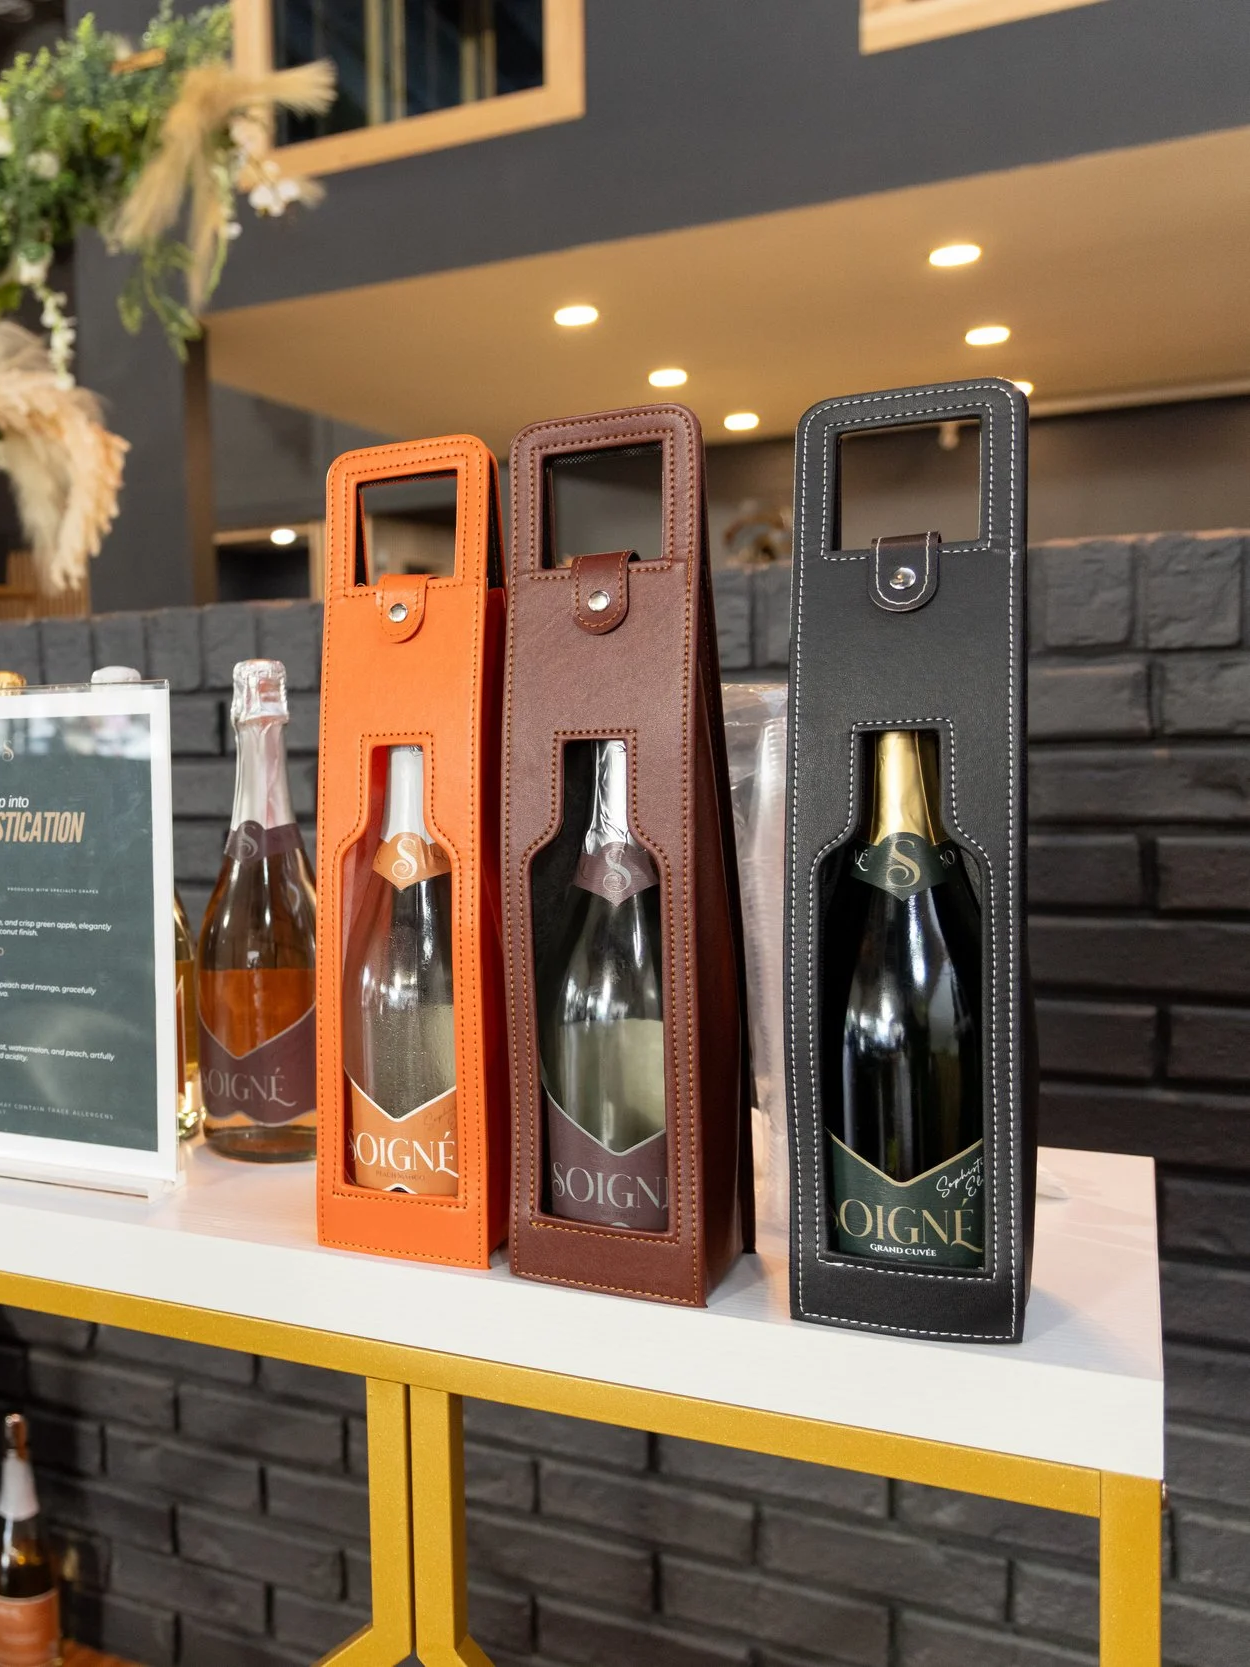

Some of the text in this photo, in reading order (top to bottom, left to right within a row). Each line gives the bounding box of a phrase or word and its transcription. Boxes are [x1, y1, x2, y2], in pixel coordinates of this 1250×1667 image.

[8, 795, 29, 808] into
[392, 838, 417, 879] S
[886, 839, 921, 888] S
[603, 849, 632, 893] S
[4, 919, 18, 927] and
[19, 920, 35, 929] crisp
[36, 921, 55, 929] green
[56, 922, 78, 930] apple,
[78, 922, 112, 932] elegantly
[19, 928, 39, 937] finish.
[0, 981, 20, 989] peach
[20, 983, 35, 991] and
[35, 984, 61, 993] mango,
[61, 986, 96, 997] gracefully
[5, 1052, 28, 1062] acidity.
[8, 1044, 50, 1055] watermelon,
[50, 1048, 66, 1056] and
[66, 1049, 89, 1059] peach,
[89, 1051, 115, 1062] artfully
[13, 1102, 45, 1112] CONTAIN
[552, 1161, 667, 1209] SOIGN
[833, 1197, 983, 1254] OIGNÉ
[869, 1242, 937, 1258] GRAND CUVÉE
